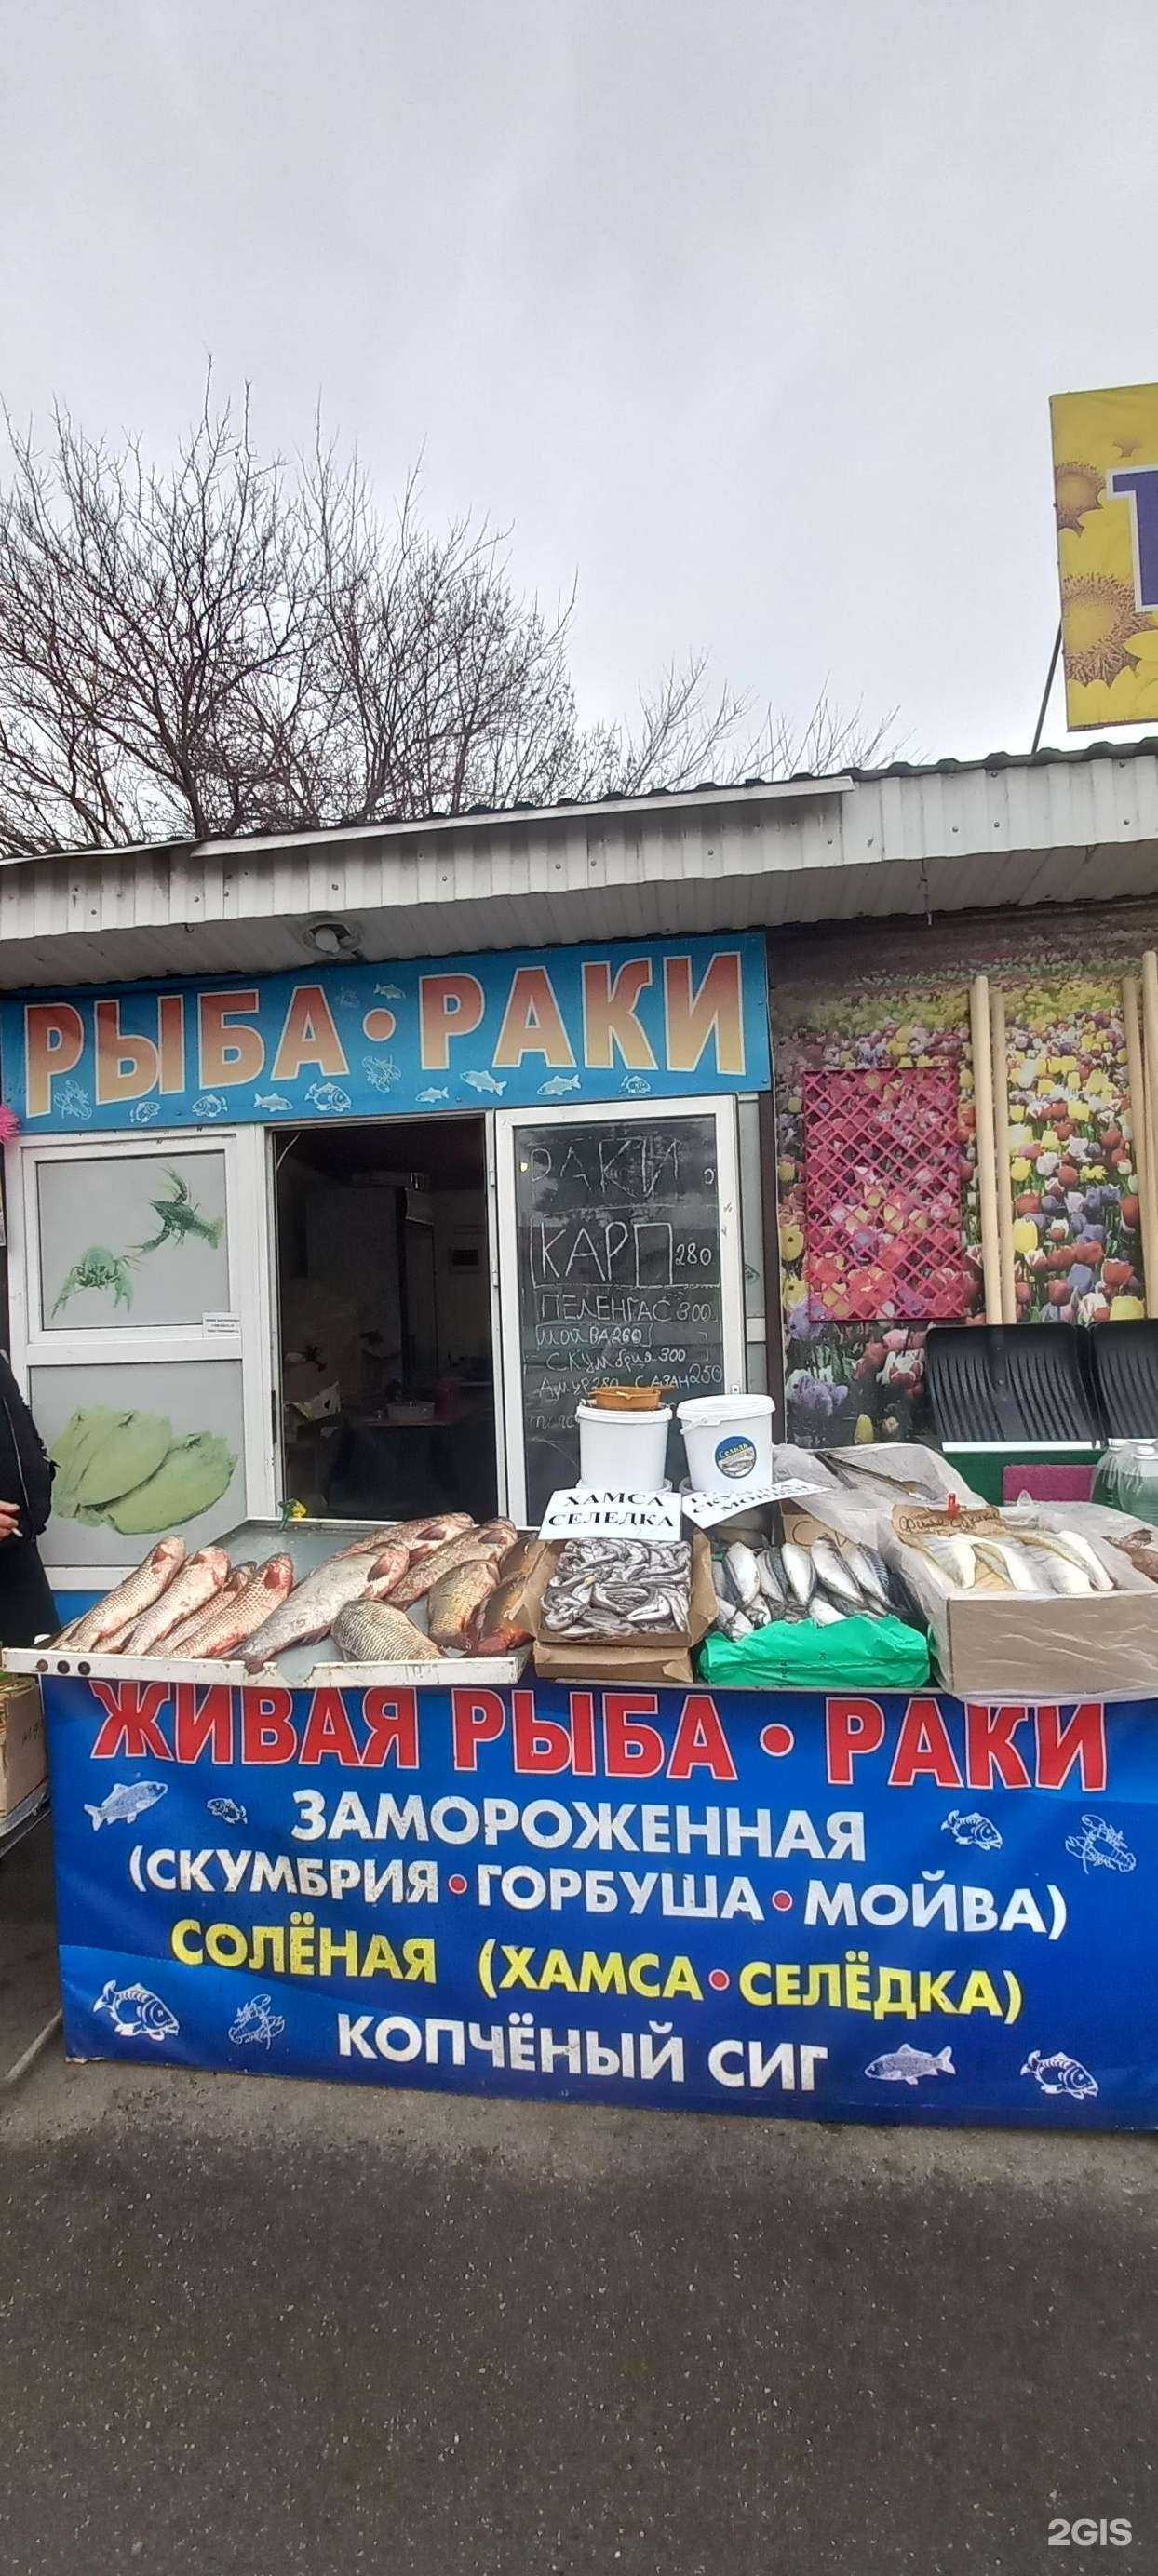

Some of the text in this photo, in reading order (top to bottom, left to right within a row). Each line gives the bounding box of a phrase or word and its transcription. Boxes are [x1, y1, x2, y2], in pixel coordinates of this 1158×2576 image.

[25, 951, 746, 1118] РЫБА РАКИ
[540, 1221, 712, 1287] КАРП 280
[676, 1302, 711, 1322] 300
[658, 1348, 686, 1362] 300
[689, 1363, 723, 1384] 250
[548, 1511, 674, 1527] СЕЛЕДКА
[564, 1492, 664, 1507] ХАМСА
[90, 1681, 1108, 1792] ЖИВАЯ РЫБА РАКИ
[291, 1789, 866, 1862] ЗАМОРОЖЕННАЯ
[129, 1845, 1068, 1940] (СКУМБРИЯ ГОРБУША МОЙВА)
[170, 1911, 1023, 2025] СОЛЁНАЯ (ХАМСА СЕЛЁДКА)
[338, 2012, 828, 2092] КОПЧЁНЫЙ СИГ
